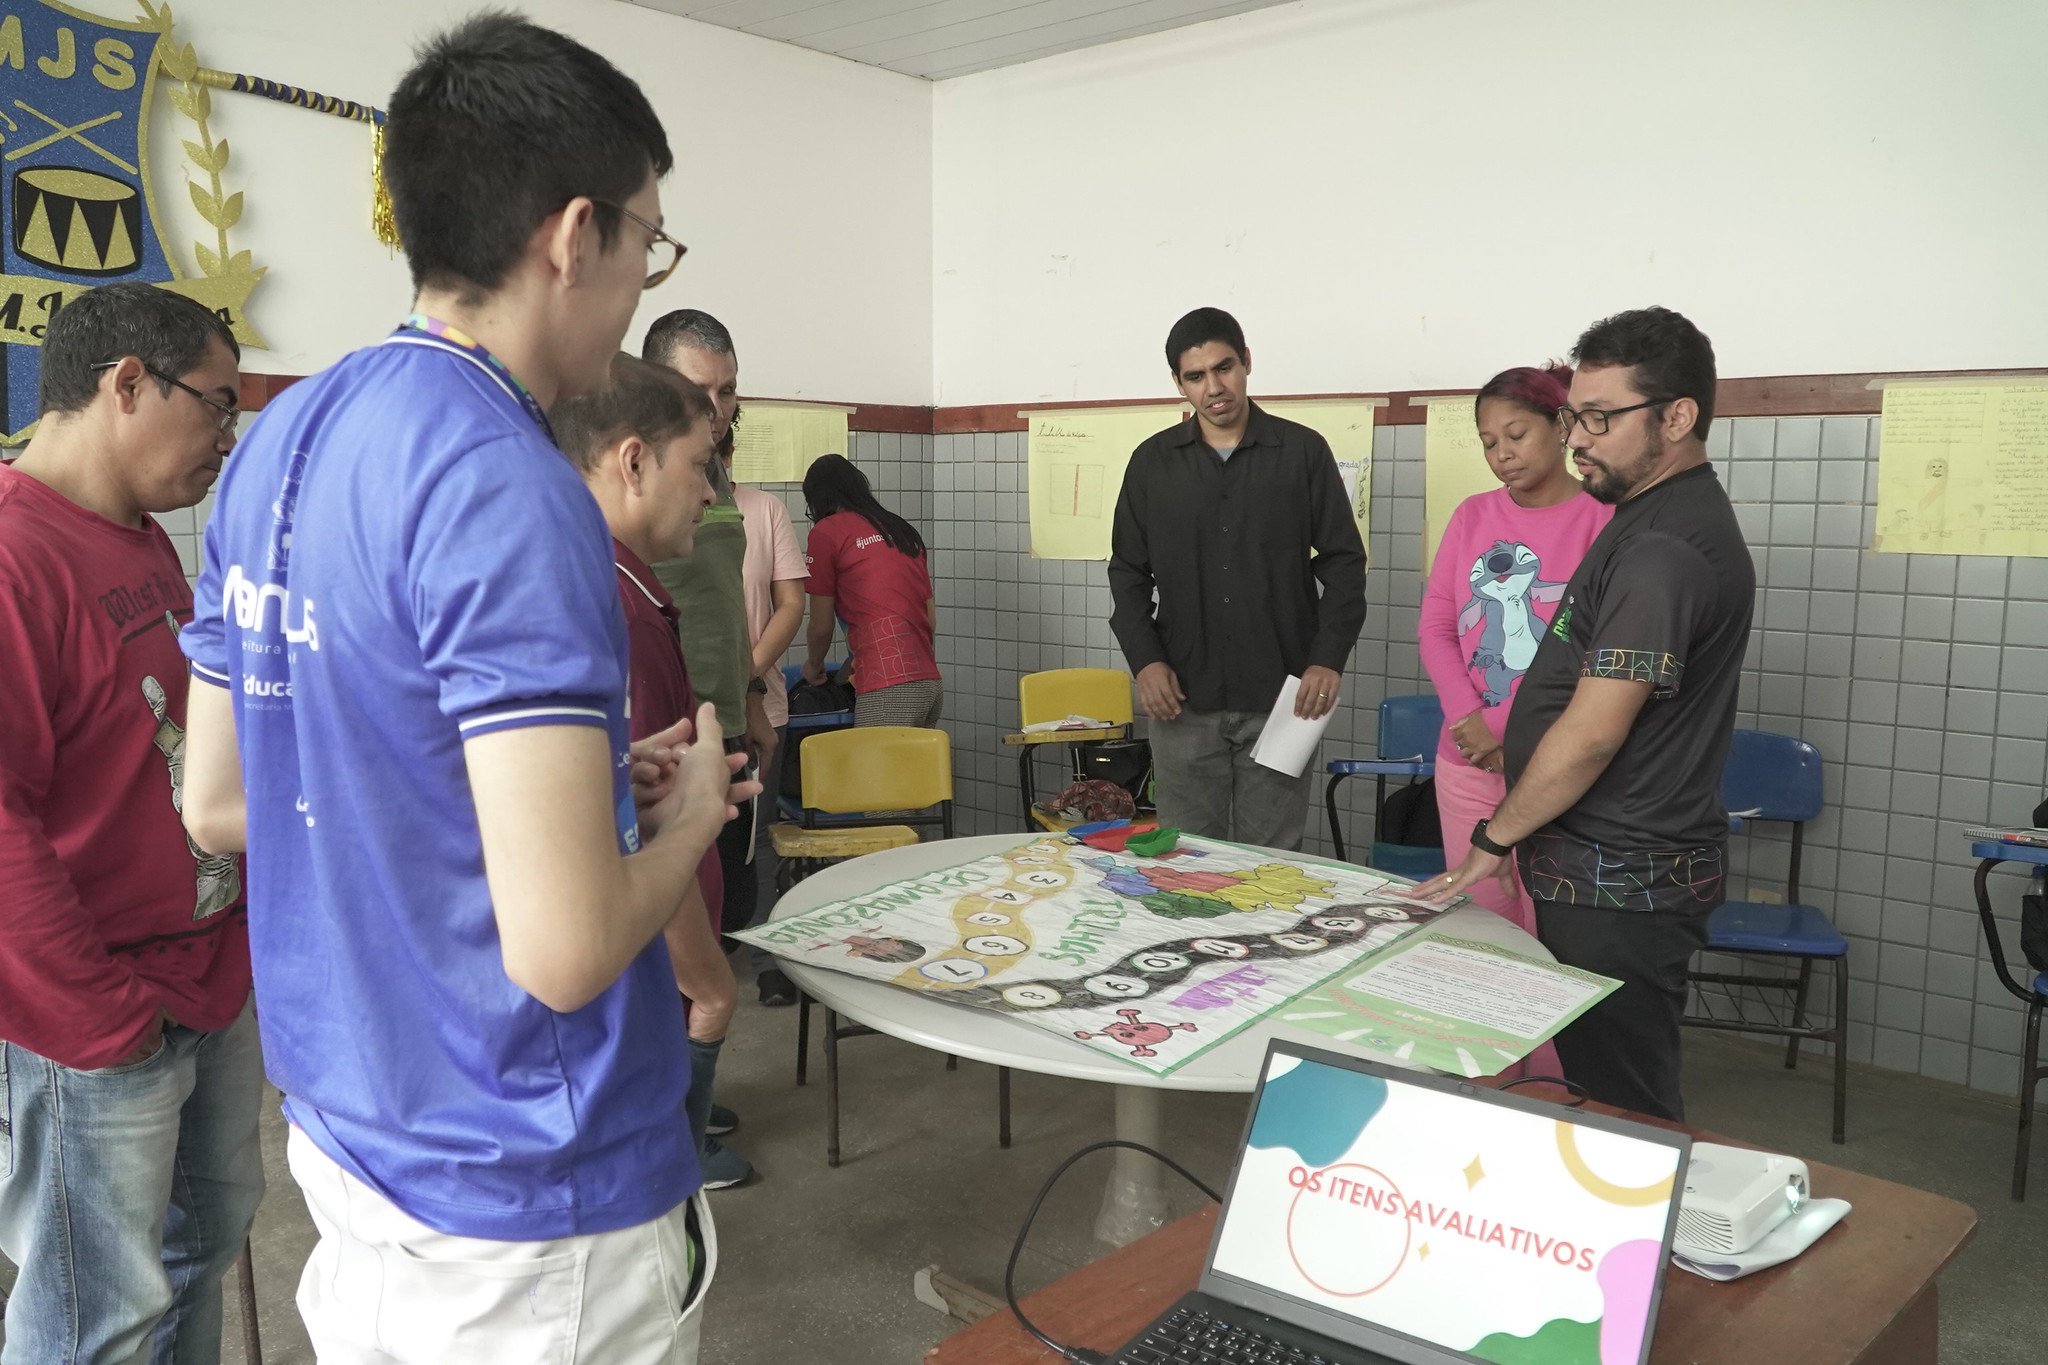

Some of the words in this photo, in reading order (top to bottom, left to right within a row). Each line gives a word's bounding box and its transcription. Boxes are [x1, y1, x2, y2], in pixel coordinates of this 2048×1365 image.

[1029, 874, 1058, 885] 3
[993, 892, 1017, 902] 4
[979, 915, 1001, 924] 5
[1324, 918, 1356, 928] 13
[1037, 898, 1128, 968] TRILHAS
[981, 941, 1009, 951] 6
[1204, 941, 1236, 955] 11
[1143, 954, 1180, 968] 10
[942, 964, 973, 977] 7
[1105, 981, 1133, 992] 9
[1019, 991, 1046, 1001] 8
[1288, 1166, 1324, 1193] OS
[1328, 1176, 1402, 1215] ITENS
[1404, 1200, 1596, 1273] AVALIATIVOS
